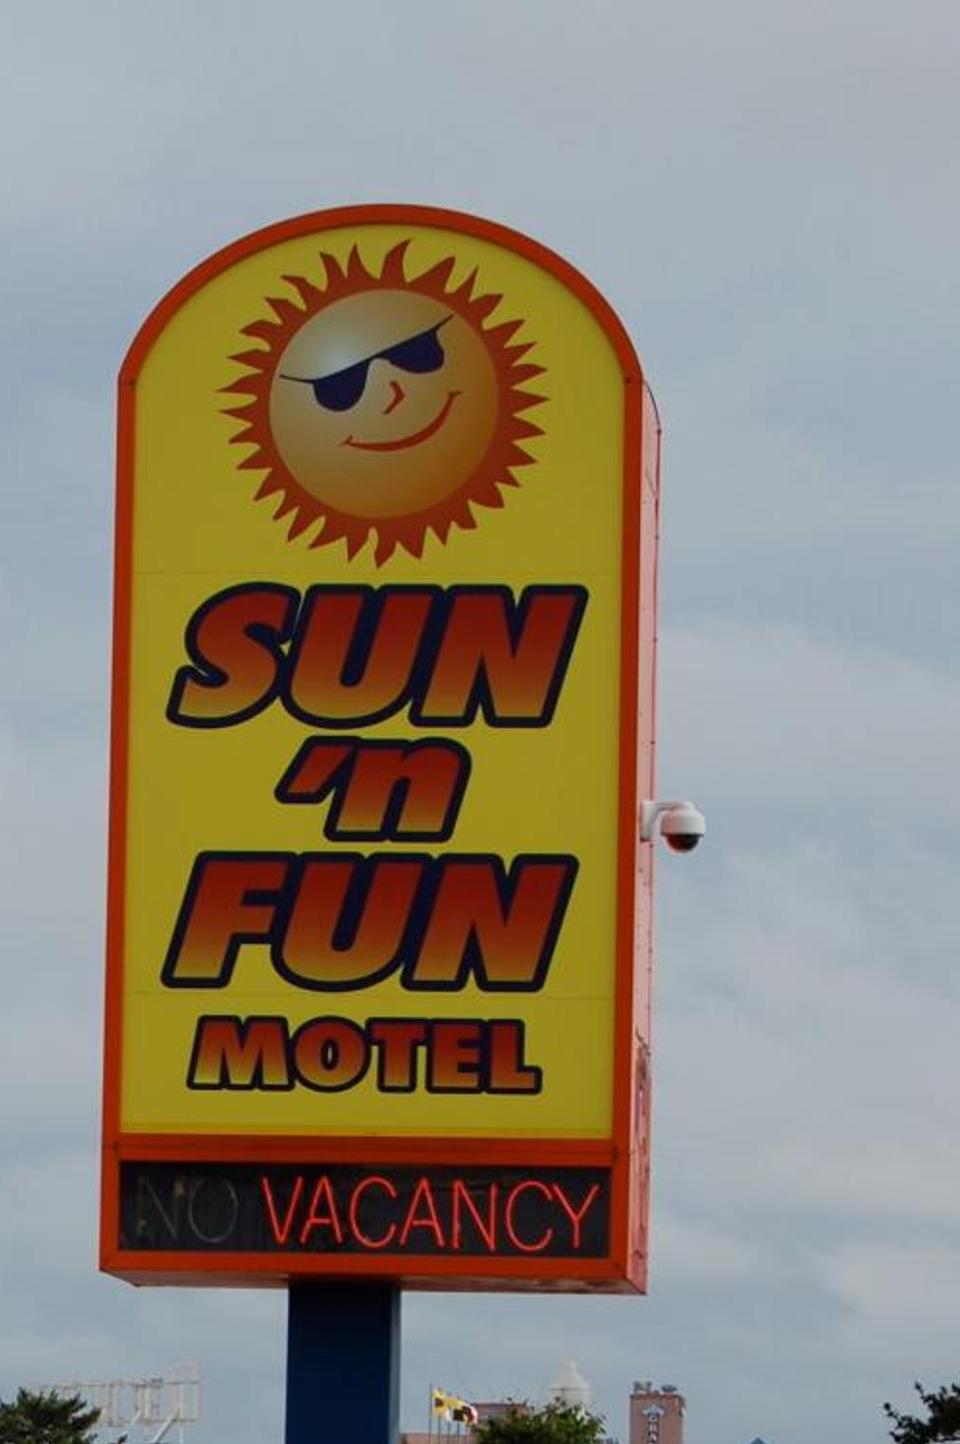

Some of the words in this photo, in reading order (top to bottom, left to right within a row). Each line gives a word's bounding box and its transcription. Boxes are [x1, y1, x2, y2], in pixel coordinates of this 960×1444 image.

[165, 581, 589, 729] SUN
[274, 736, 472, 842] 'n
[160, 851, 579, 992] FUN
[187, 1015, 543, 1094] MOTEL
[135, 1174, 239, 1244] NO
[262, 1175, 600, 1252] VACANCY
